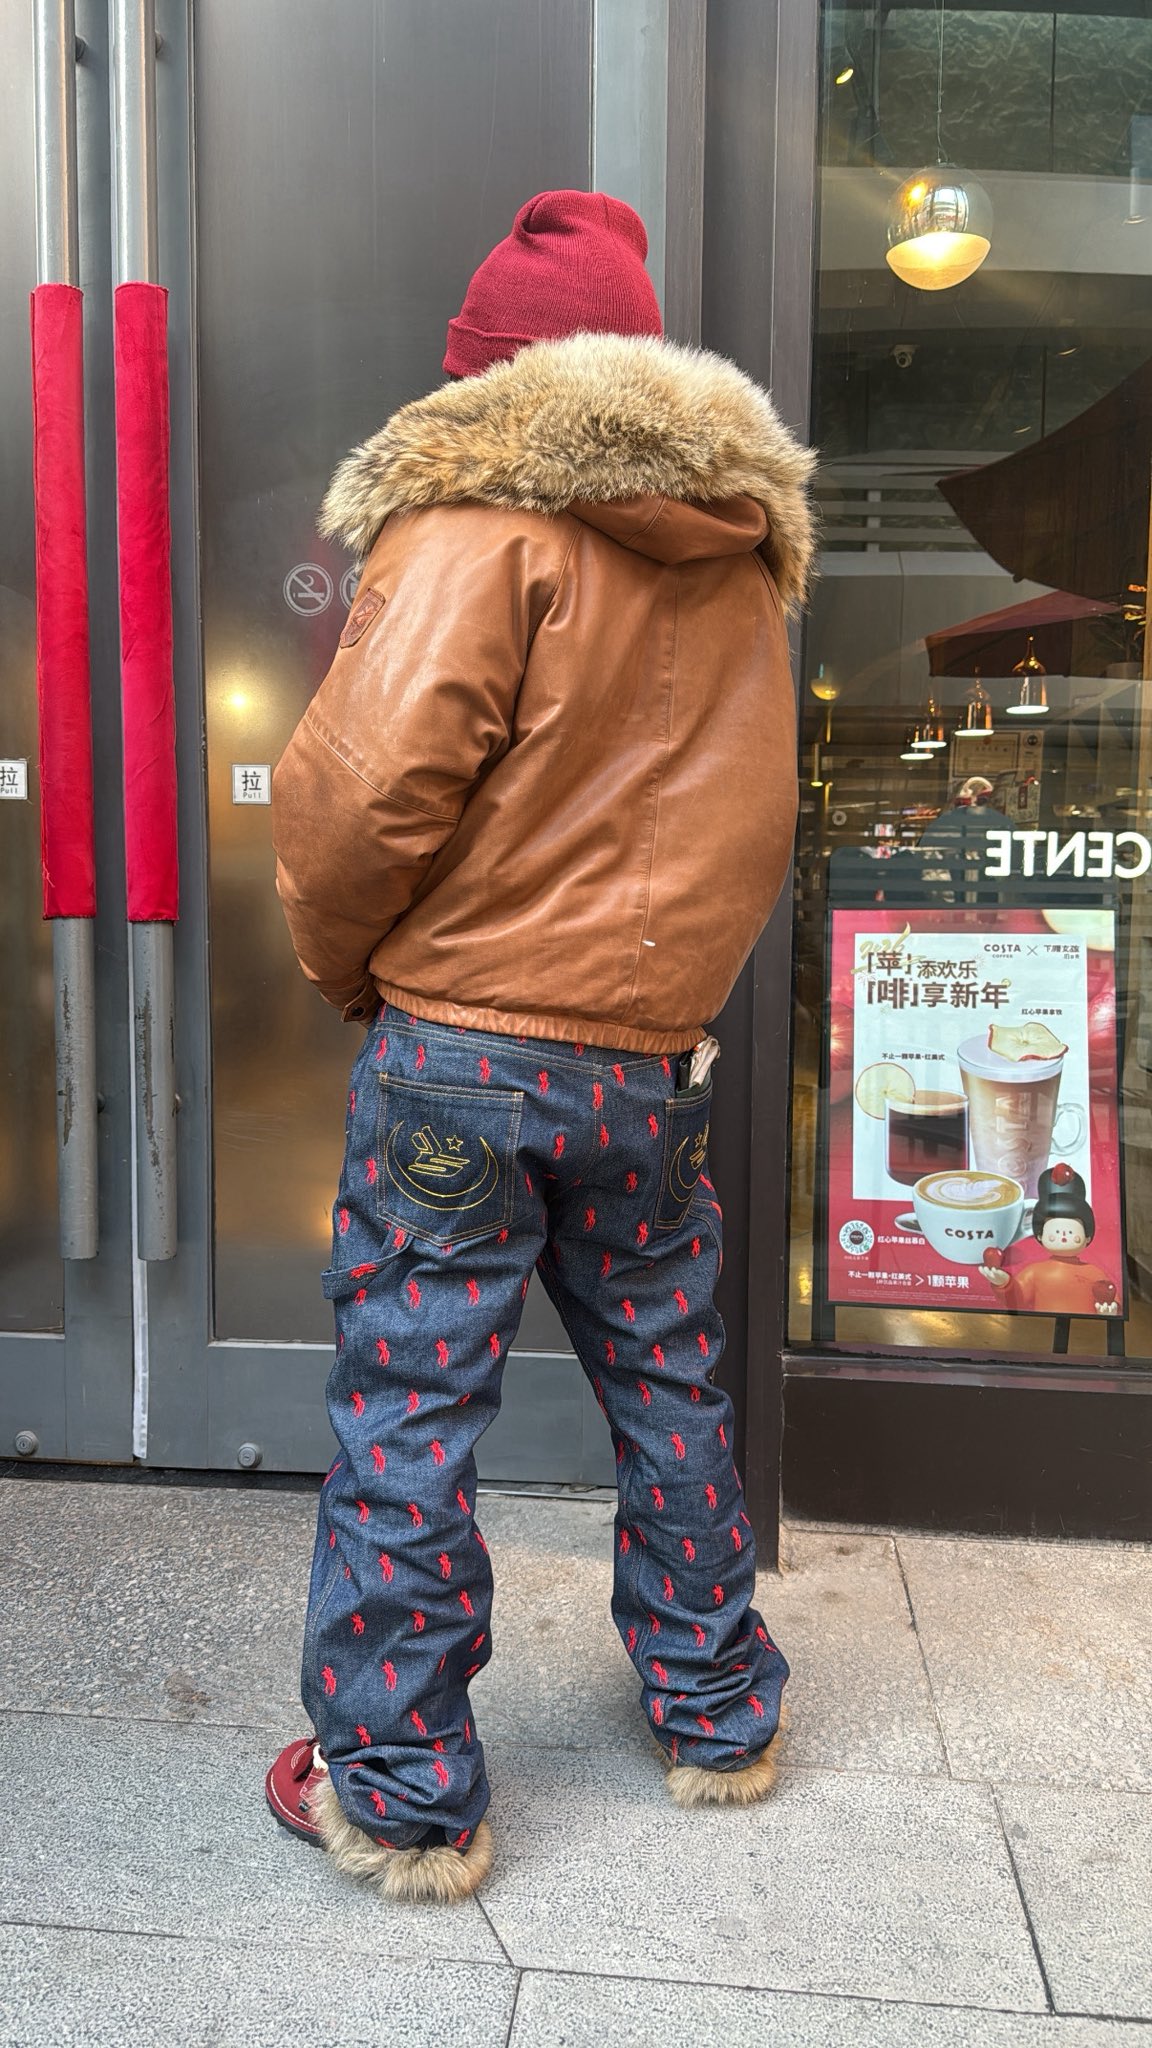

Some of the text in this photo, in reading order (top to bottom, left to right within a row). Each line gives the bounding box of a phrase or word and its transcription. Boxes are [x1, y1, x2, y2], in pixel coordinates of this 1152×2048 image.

[0, 766, 18, 786] 拉
[242, 770, 262, 791] 拉
[243, 791, 261, 799] Pull
[984, 944, 1021, 953] COSTA
[945, 1228, 994, 1241] COSTA
[927, 1274, 970, 1289] 1颗苹果
